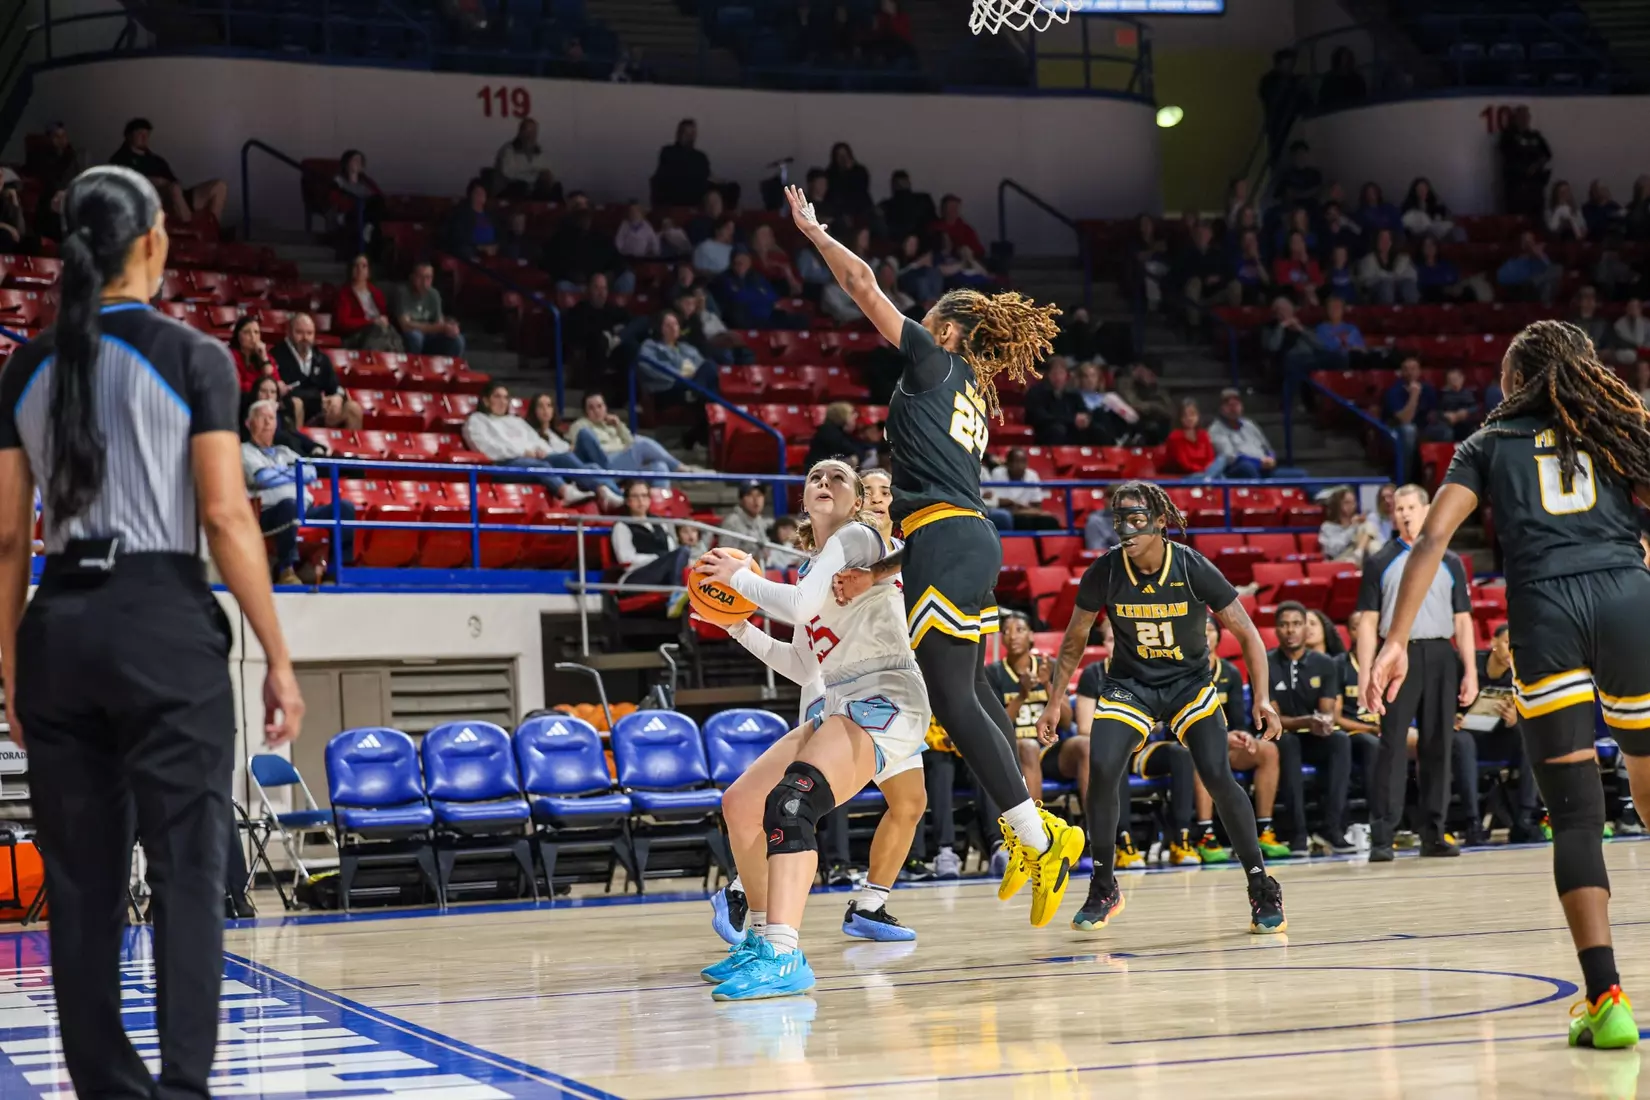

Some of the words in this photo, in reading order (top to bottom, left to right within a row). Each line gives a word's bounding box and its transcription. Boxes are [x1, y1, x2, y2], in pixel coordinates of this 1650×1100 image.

[477, 85, 531, 118] 119
[1479, 104, 1531, 134] 10
[699, 583, 736, 606] NCAA
[1115, 601, 1189, 618] KENNESAW
[1135, 621, 1175, 648] 21
[0, 751, 28, 760] TORAD
